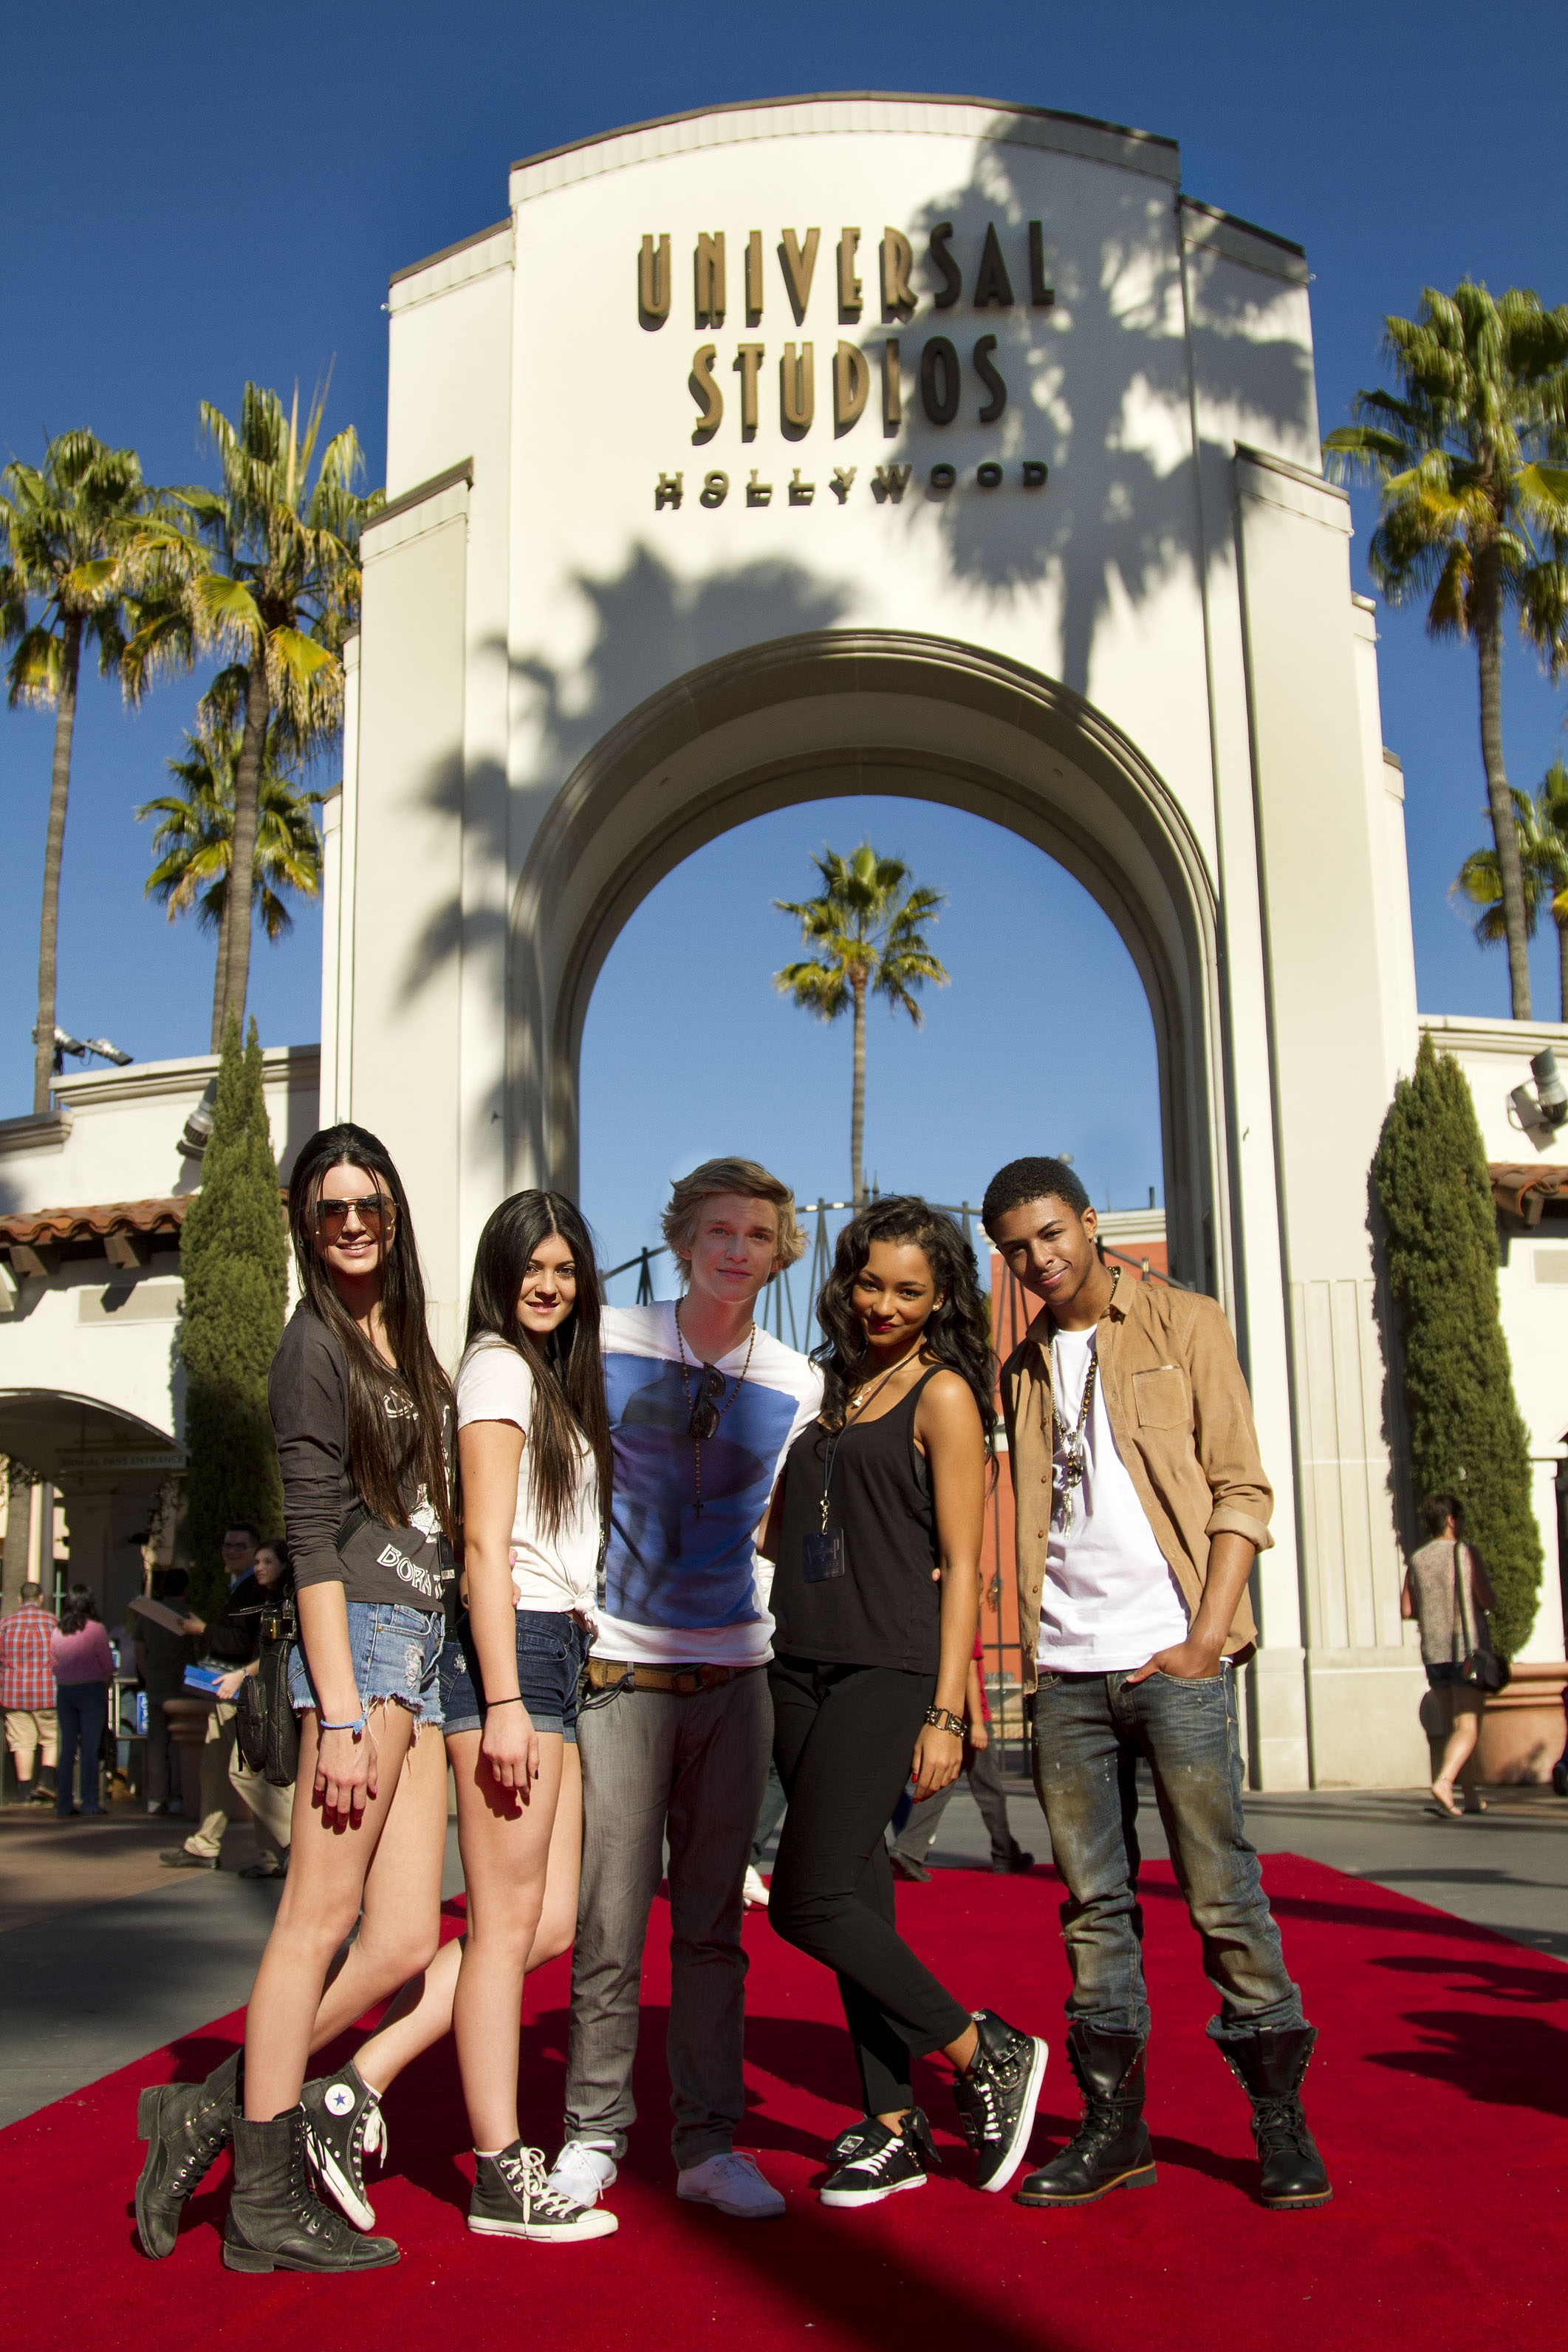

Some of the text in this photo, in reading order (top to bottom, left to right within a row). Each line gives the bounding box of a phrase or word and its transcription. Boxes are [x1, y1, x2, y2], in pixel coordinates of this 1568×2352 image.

[639, 219, 1055, 318] UNIVERSAL
[688, 334, 1007, 431] STUDIOS
[657, 461, 1049, 499] HOLLYWOOD
[102, 1457, 129, 1466] PASS
[129, 1455, 184, 1466] ENTRANCE
[376, 1543, 431, 1596] BORN
